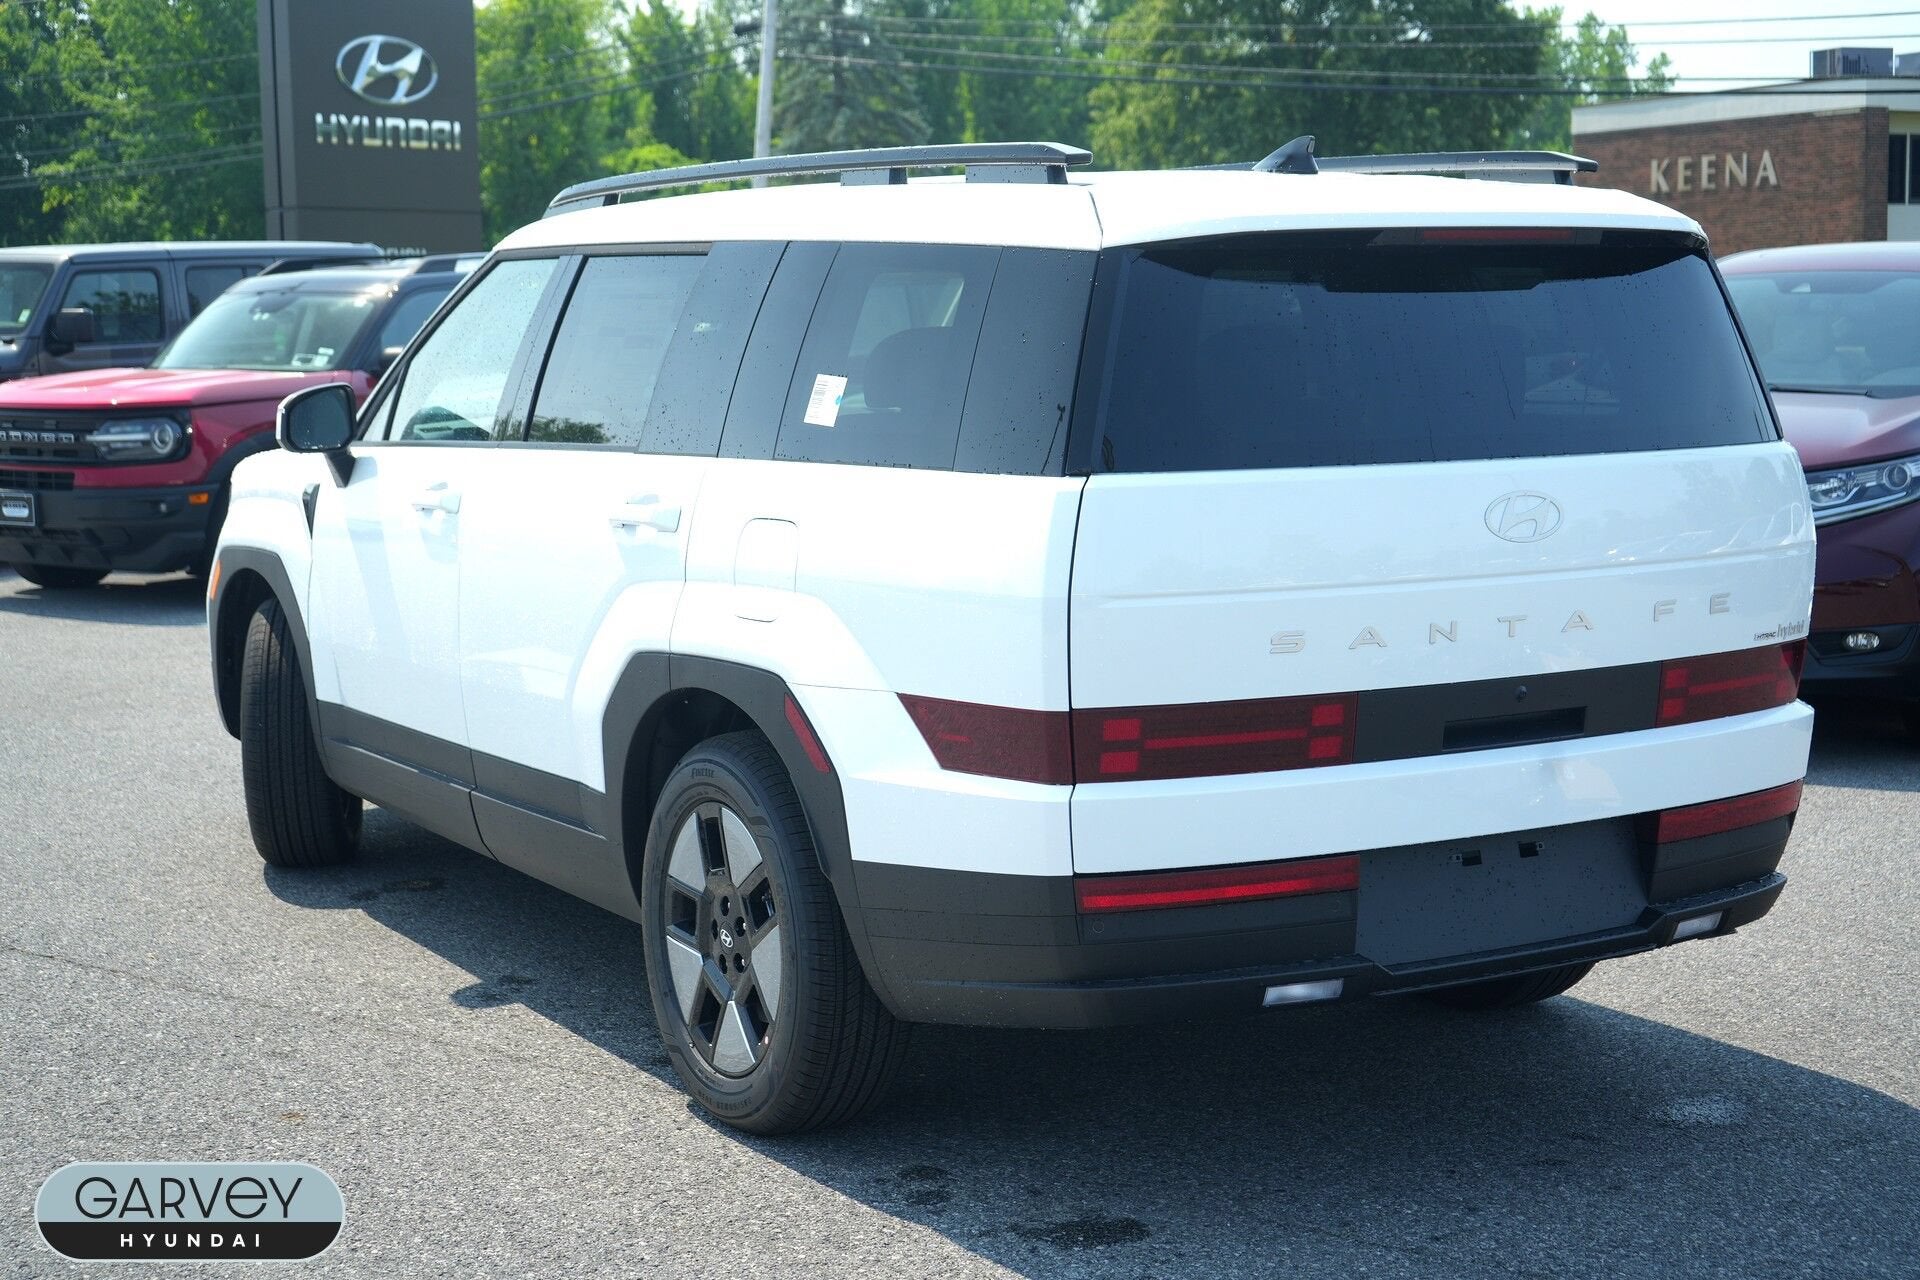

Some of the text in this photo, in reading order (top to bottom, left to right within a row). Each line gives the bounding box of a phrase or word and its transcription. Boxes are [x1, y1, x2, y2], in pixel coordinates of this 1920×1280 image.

[315, 112, 461, 150] HYUNDAI
[1650, 150, 1778, 194] KEENA
[1269, 592, 1731, 655] SANTA FE
